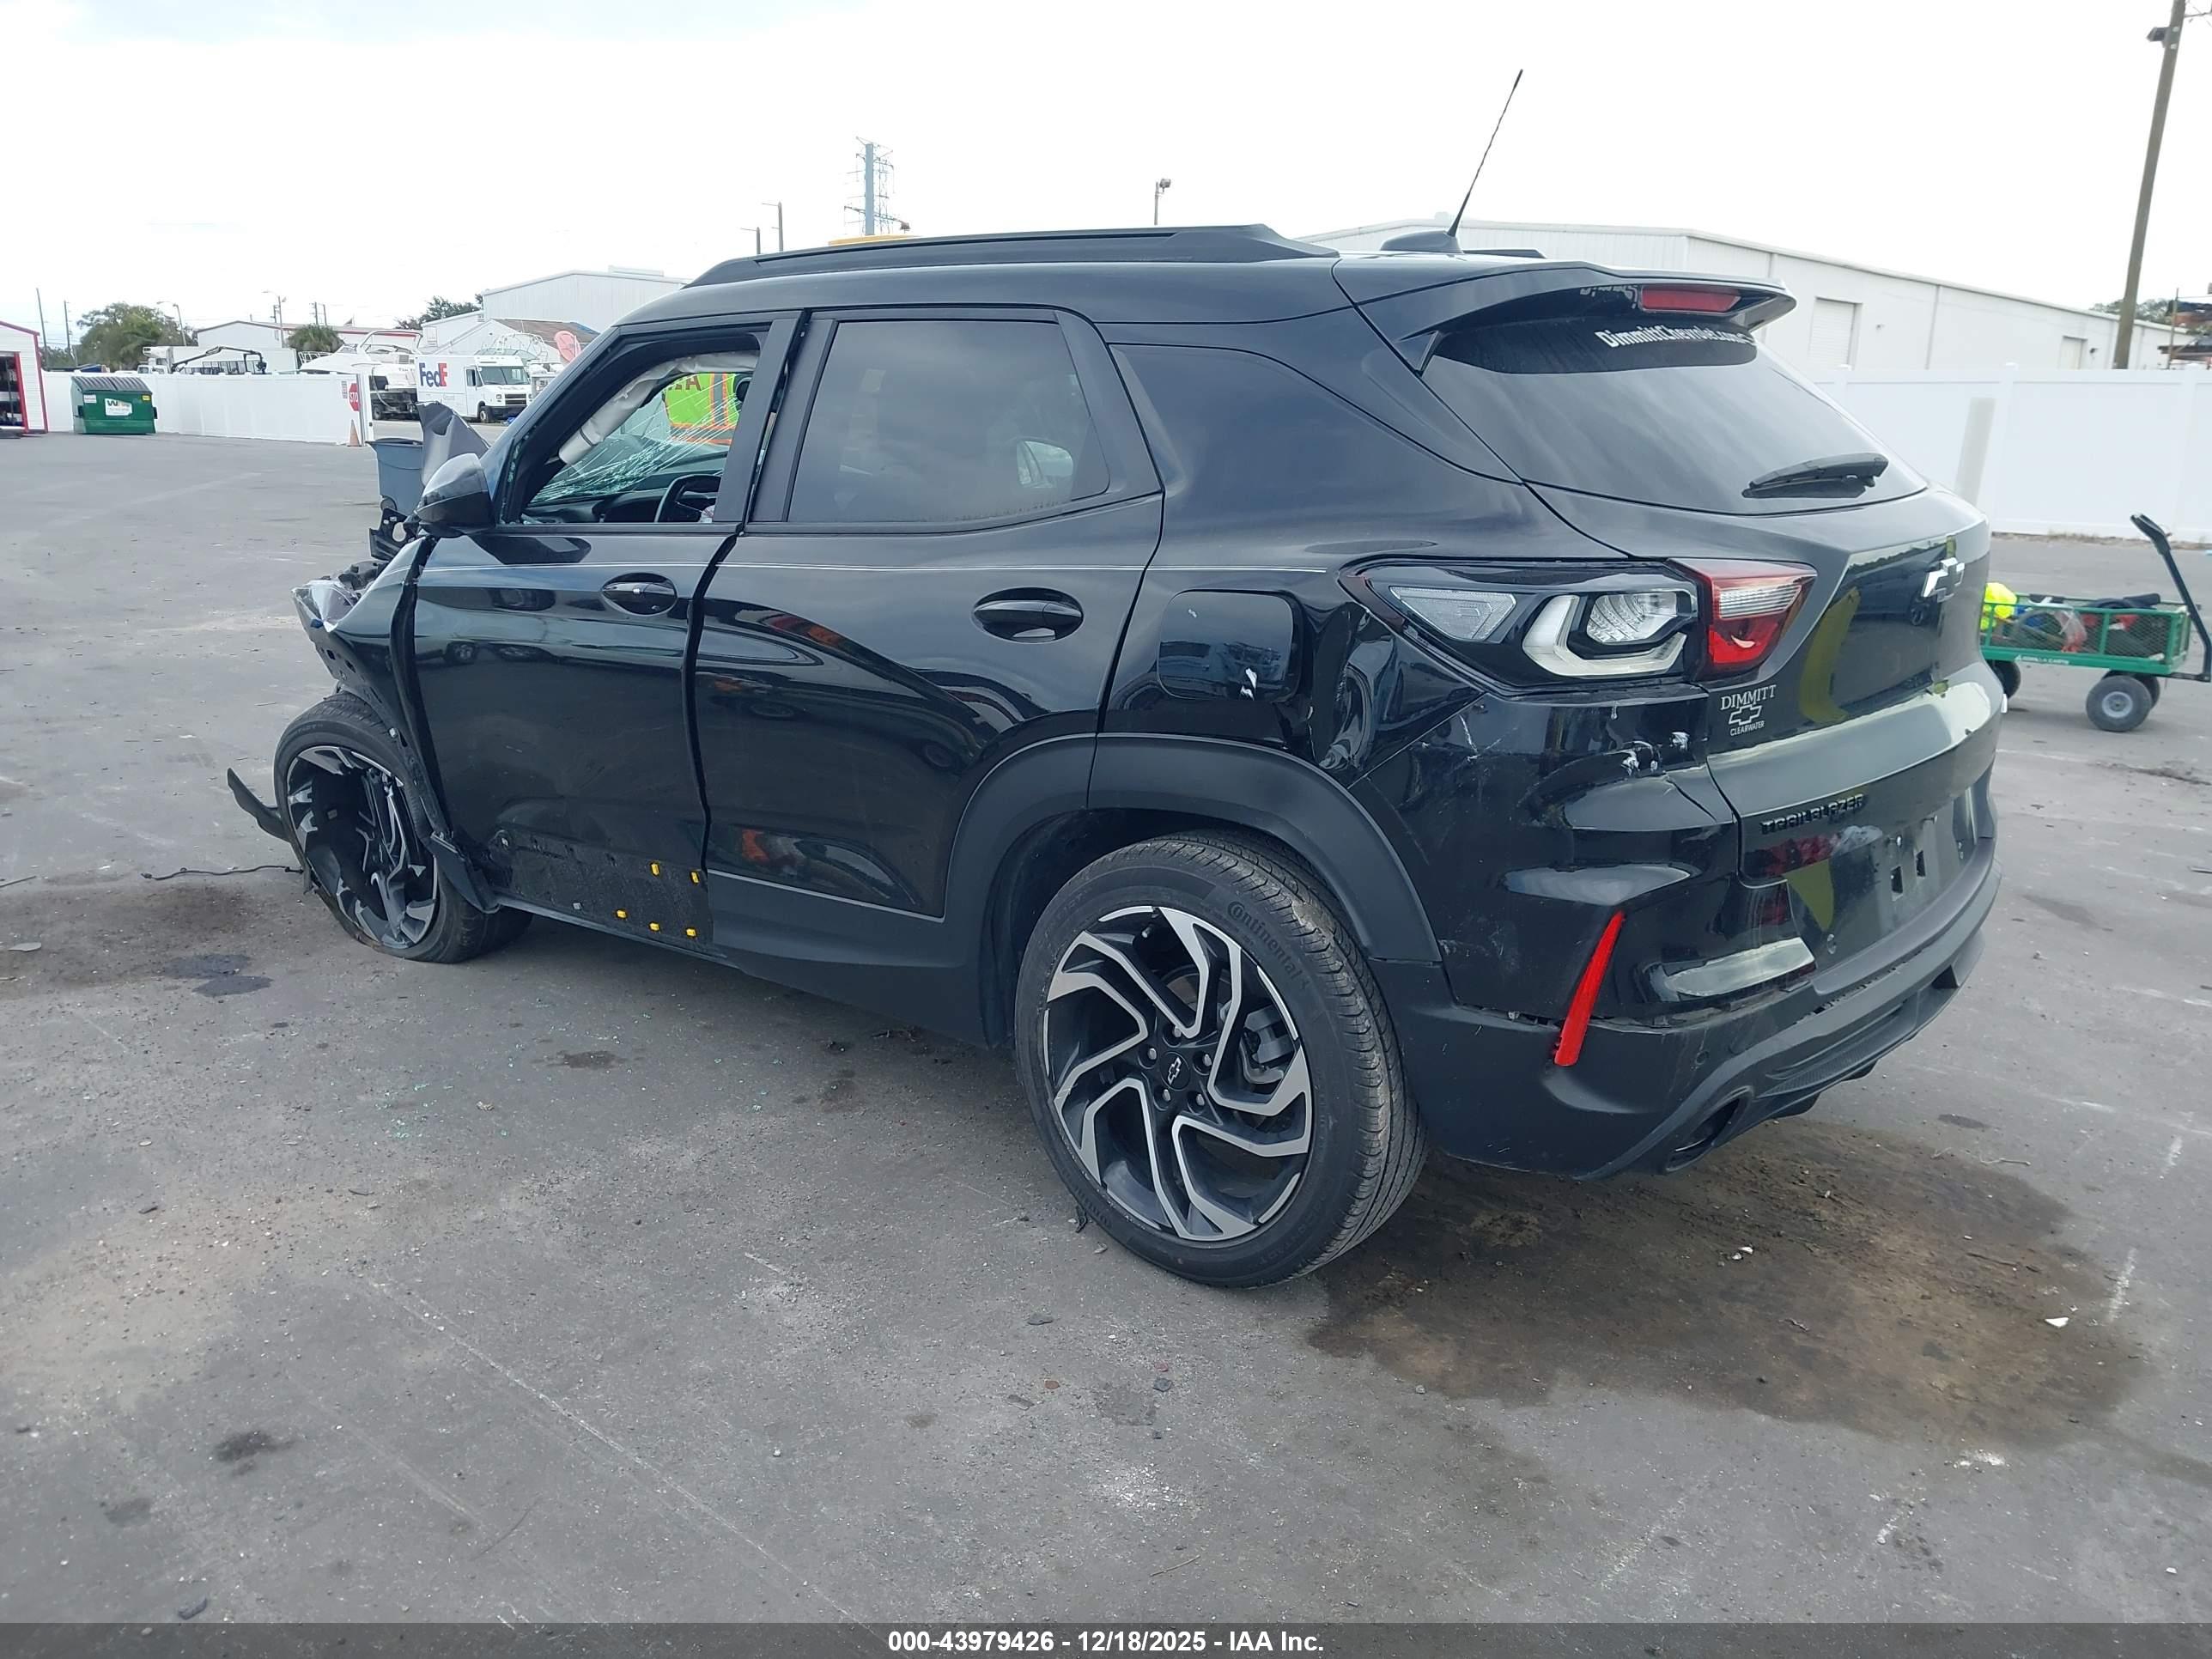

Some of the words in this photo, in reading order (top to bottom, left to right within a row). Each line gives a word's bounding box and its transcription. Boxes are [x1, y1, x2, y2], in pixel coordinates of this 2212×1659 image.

[349, 392, 359, 403] STO
[1720, 684, 1777, 710] DIMMITT
[1729, 720, 1765, 736] CLEARWATER
[1228, 901, 1303, 978] Continental
